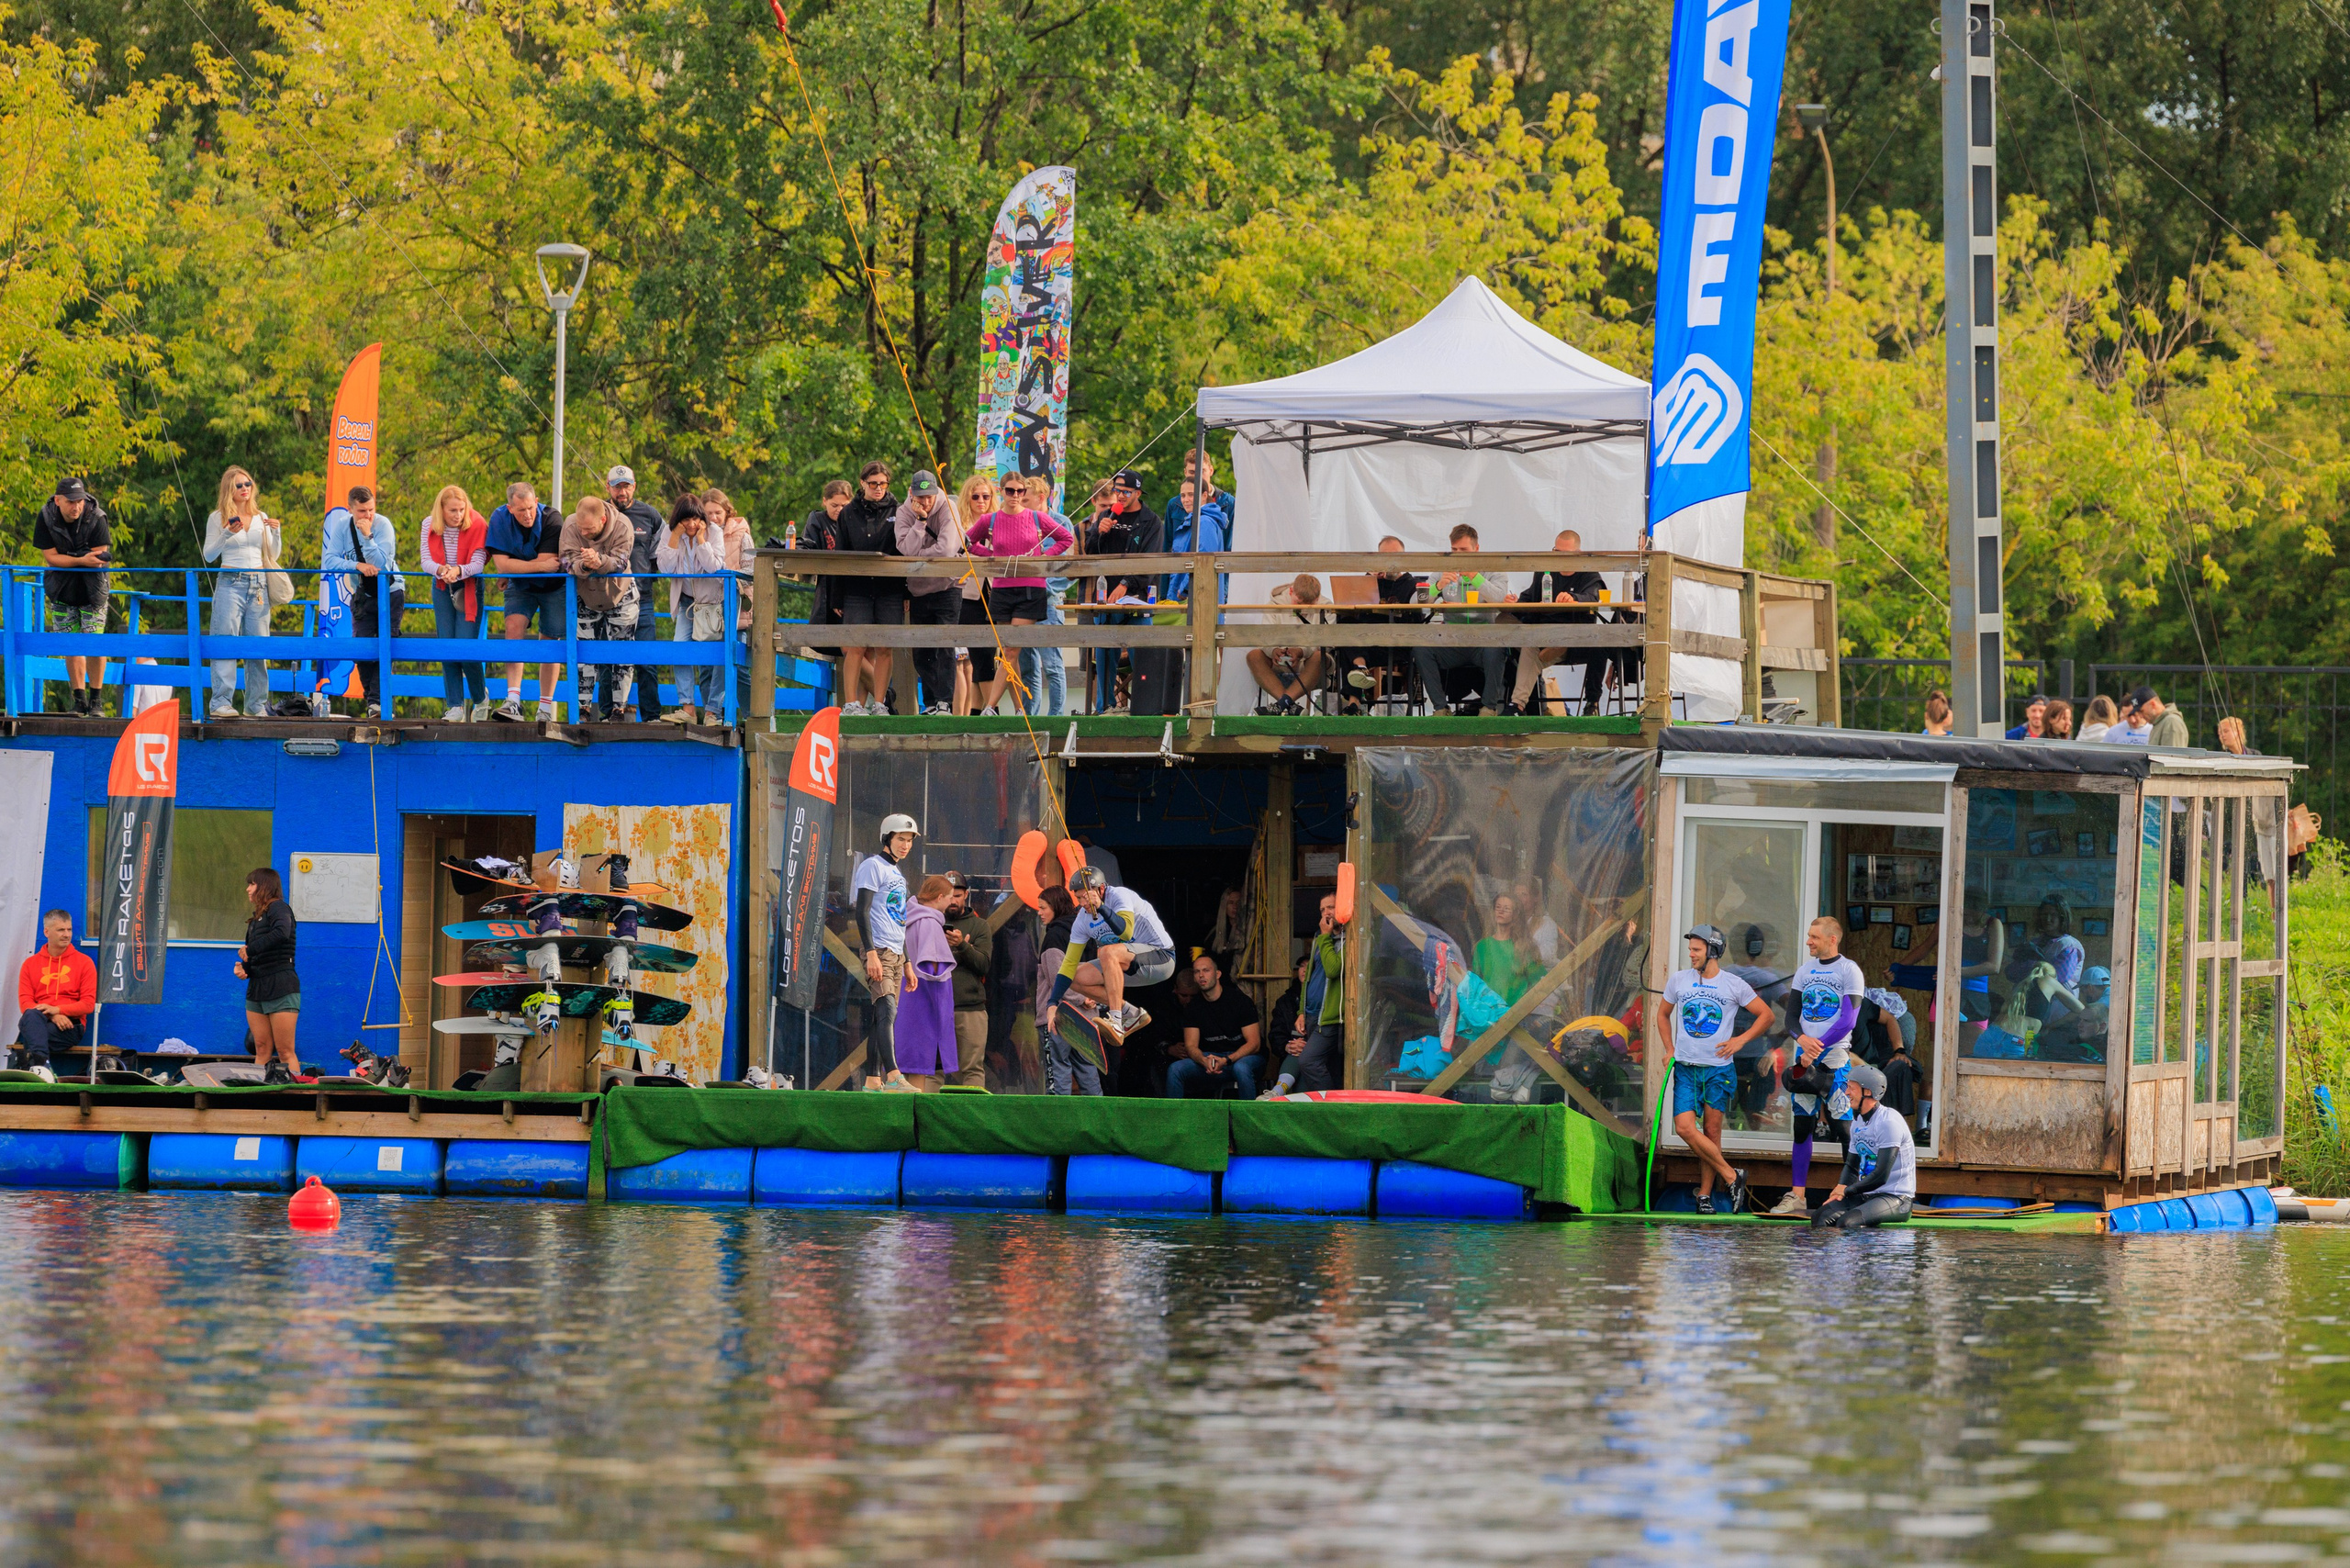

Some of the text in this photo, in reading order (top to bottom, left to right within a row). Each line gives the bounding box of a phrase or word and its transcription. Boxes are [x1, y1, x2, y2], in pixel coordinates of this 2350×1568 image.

[112, 812, 136, 991] LOS RAKETOS
[779, 806, 805, 988] LOS RAKETOS
